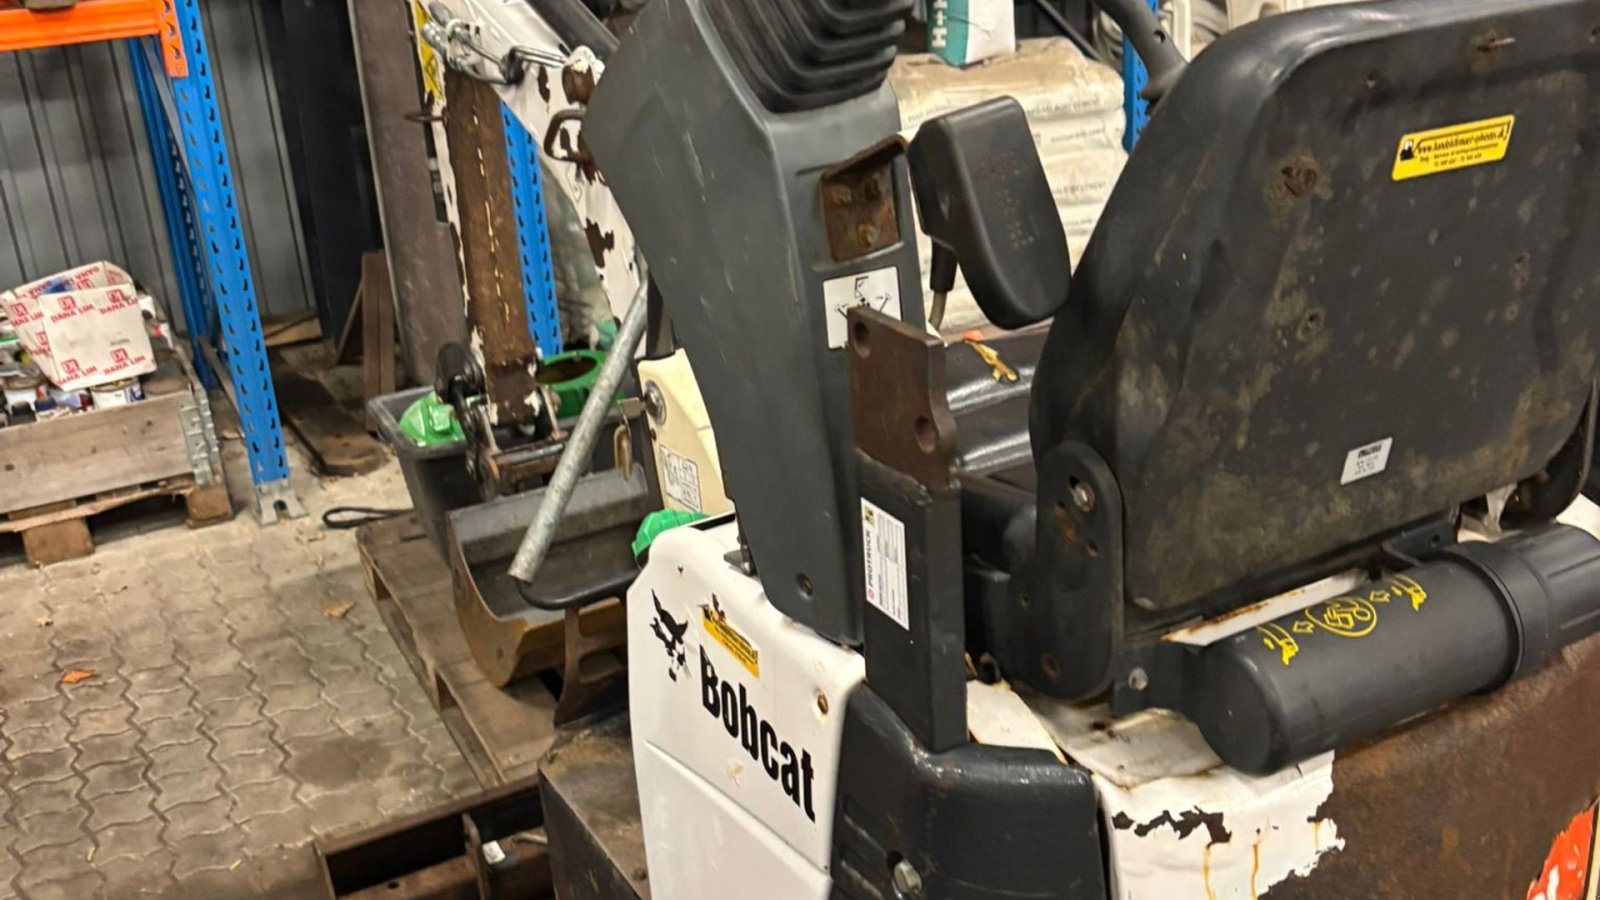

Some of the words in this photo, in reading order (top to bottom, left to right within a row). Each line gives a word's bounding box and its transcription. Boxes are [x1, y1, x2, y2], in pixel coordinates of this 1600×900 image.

[51, 309, 77, 323] DANA
[79, 303, 95, 315] LIM
[99, 302, 126, 315] DANA
[81, 365, 98, 377] LIM
[104, 362, 130, 376] DANA
[130, 355, 146, 366] LIM
[864, 529, 874, 588] PROTRUCK
[699, 644, 816, 823] Bobcat
